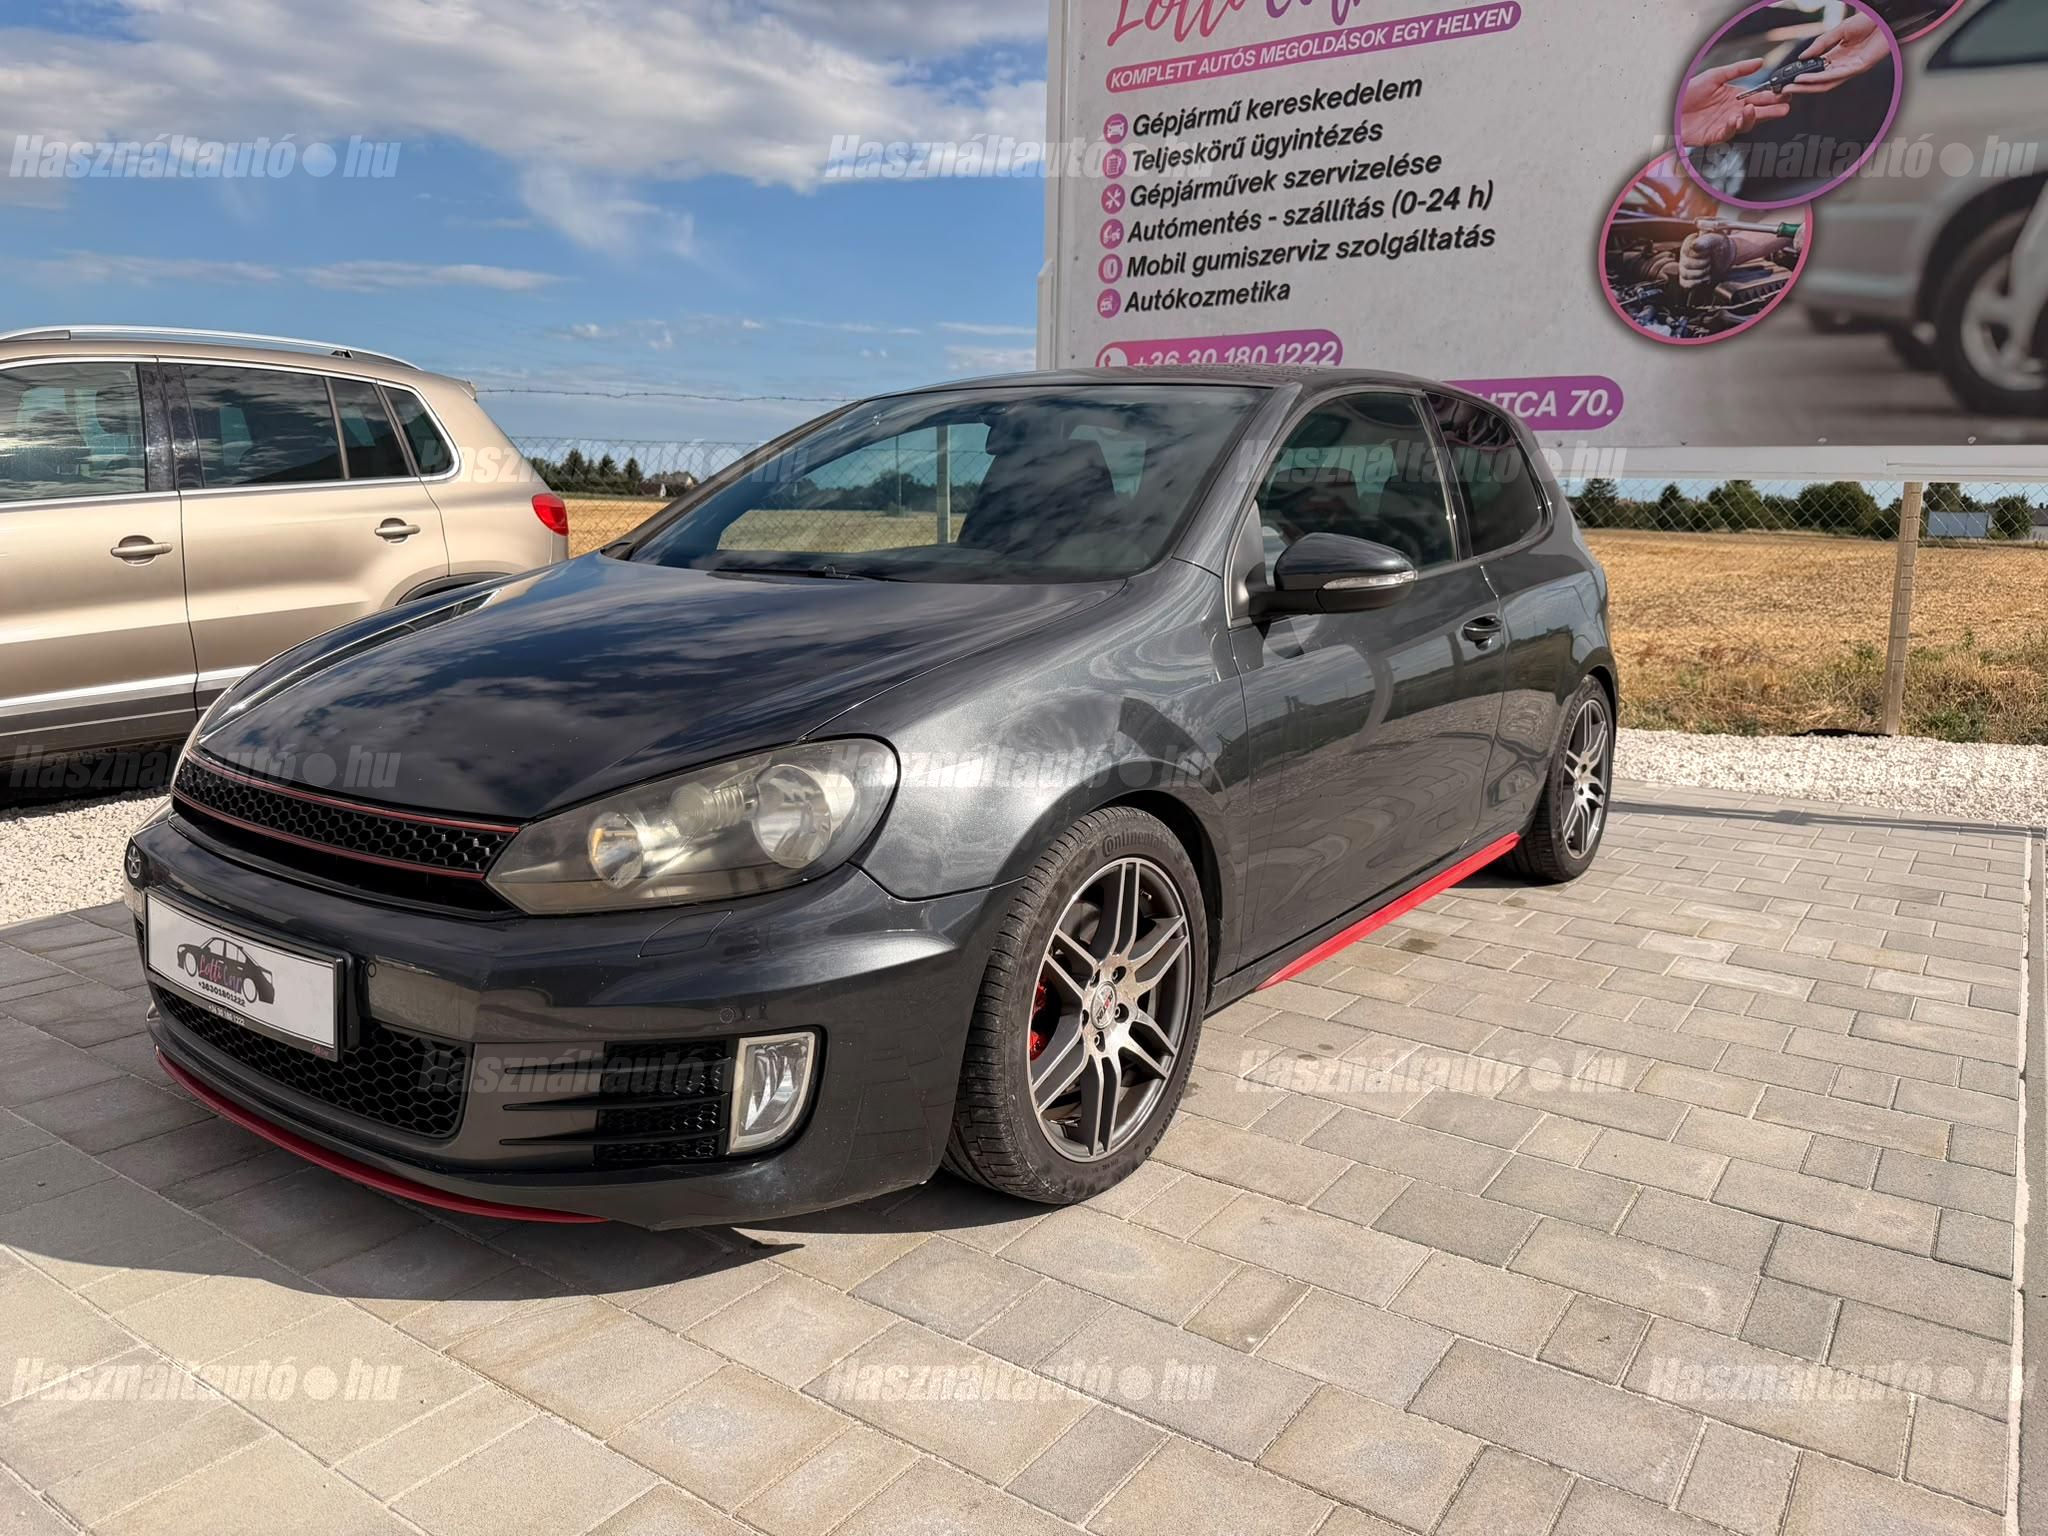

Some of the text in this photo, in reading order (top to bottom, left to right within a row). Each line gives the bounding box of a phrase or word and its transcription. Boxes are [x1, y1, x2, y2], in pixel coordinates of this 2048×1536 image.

[1110, 6, 1515, 89] KOMPLETT AUTÓS MEGOLDÁSOK EGY HELYEN
[1132, 78, 1423, 138] Gépjármű kereskedelem
[1132, 120, 1384, 174] Teljeskörű ügyintézés
[1130, 152, 1442, 209] Gépjárművek szervizelése
[1127, 209, 1262, 243] Autómentés
[1282, 196, 1385, 226] szállítás
[1391, 186, 1461, 219] (0-24
[1467, 180, 1494, 210] h)
[1126, 224, 1496, 278] Mobil gumiszerviz szolgáltatás
[1124, 279, 1291, 313] Autókozmetika
[1567, 388, 1613, 417] 70.
